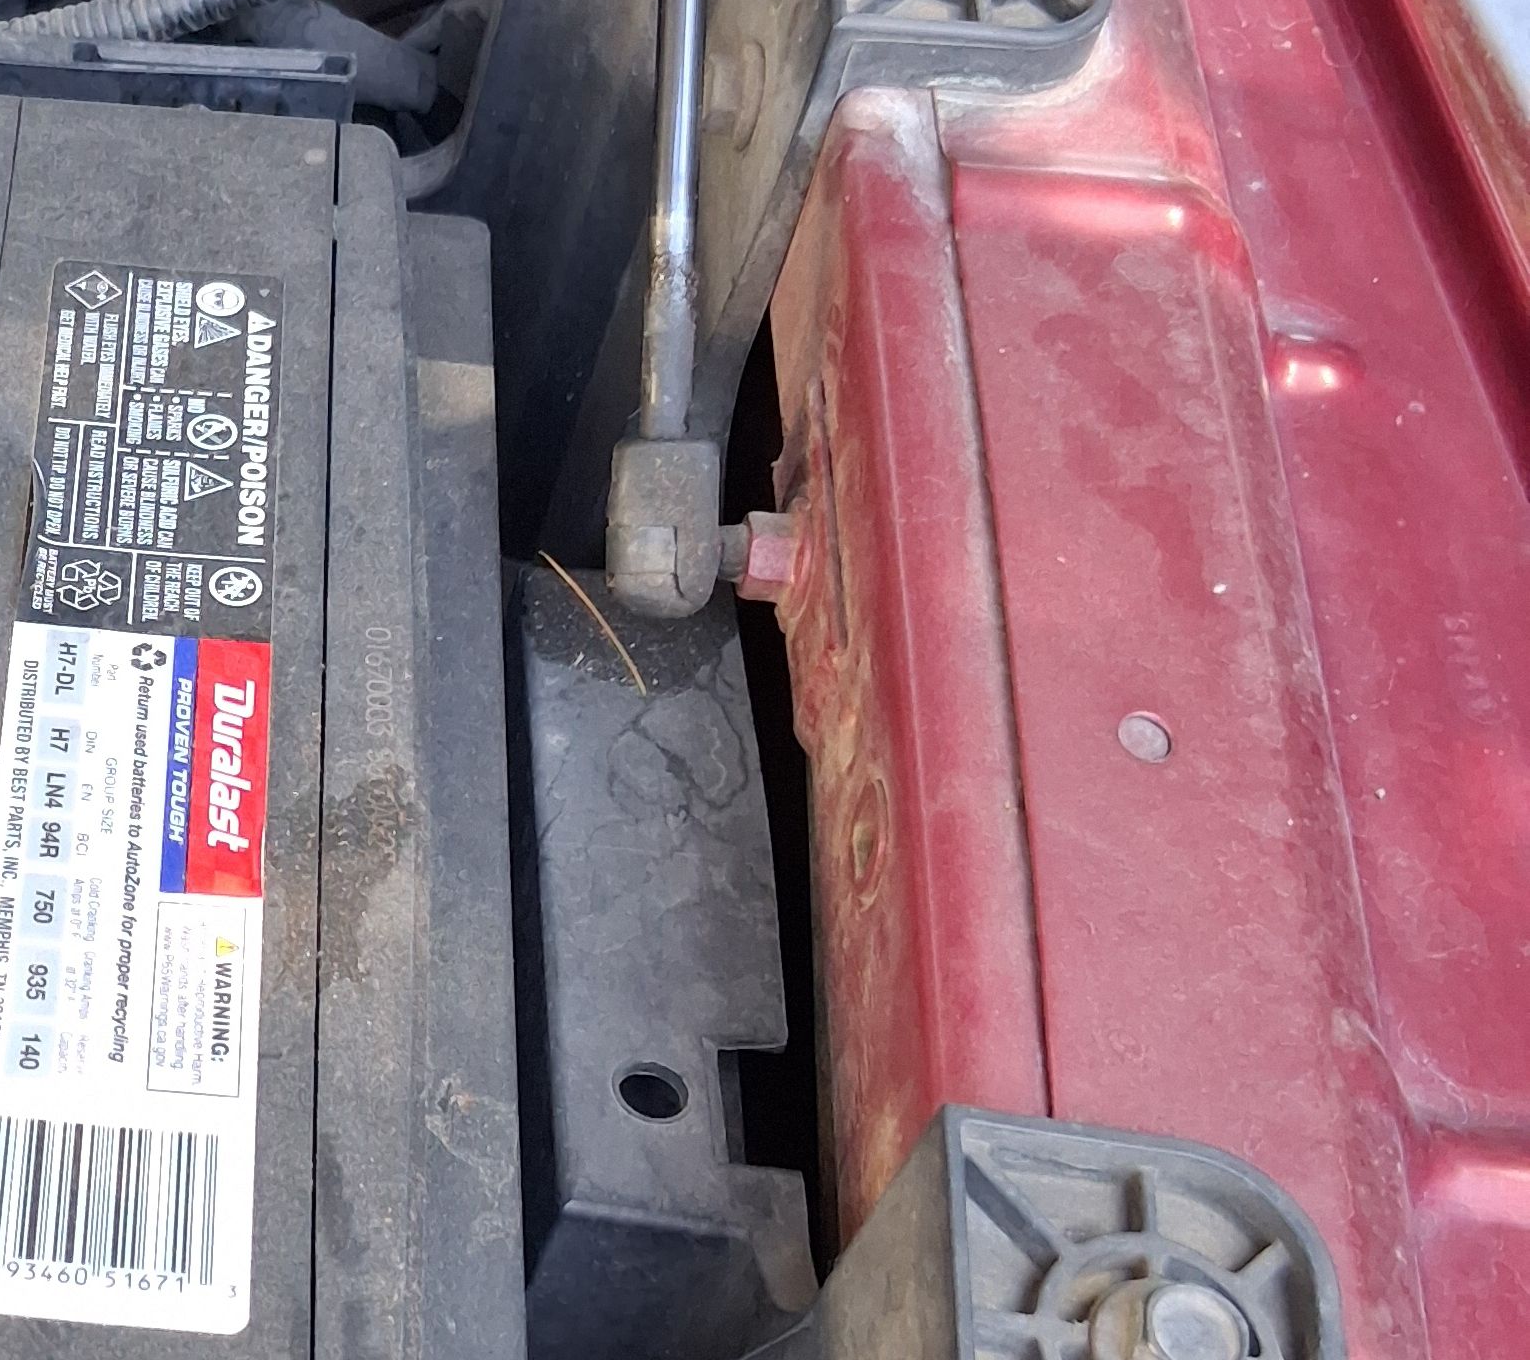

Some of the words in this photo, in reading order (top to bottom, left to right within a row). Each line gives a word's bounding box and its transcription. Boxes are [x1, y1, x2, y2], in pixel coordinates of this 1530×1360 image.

[136, 278, 153, 303] CAUSE
[152, 280, 174, 333] EXPLOSIVE
[173, 281, 193, 316] SHIELD
[57, 308, 75, 326] GET
[82, 310, 100, 334] WITH
[101, 312, 119, 341] FLUSH
[171, 316, 190, 347] EYES.
[54, 325, 74, 363] MEDICAL
[79, 333, 98, 366] WATER.
[99, 340, 117, 363] EYES
[132, 343, 148, 357] OR
[150, 333, 170, 367] GASES
[51, 362, 70, 386] HELP
[148, 366, 165, 384] CAN
[49, 385, 68, 410] FAST.
[186, 397, 206, 414] NO
[53, 425, 71, 440] DO
[124, 400, 144, 445] SMOKING
[145, 402, 163, 440] FLAMES
[165, 403, 183, 441] SPARKS
[51, 439, 70, 459] NOT
[88, 428, 107, 459] READ
[237, 332, 272, 546] DANGER/POISON
[122, 455, 139, 471] OR
[140, 457, 158, 491] CAUSE
[48, 476, 66, 491] DO
[119, 470, 138, 508] SEVERE
[158, 458, 180, 505] SULFURIC
[46, 489, 64, 510] NOT
[43, 509, 63, 536] OPEN.
[135, 490, 156, 546] BLINDNESS
[157, 505, 178, 530] ACID
[36, 546, 48, 560] BE
[155, 529, 174, 549] CAN
[44, 548, 58, 586] BATTERY
[144, 559, 162, 574] OF
[164, 561, 182, 580] THE
[184, 563, 203, 587] KEEP
[30, 559, 47, 610] RECYCLED
[41, 587, 55, 614] MUST
[82, 577, 97, 593] Pb
[140, 573, 161, 623] CHILDREN.
[162, 580, 181, 612] REACH
[183, 586, 201, 607] OUT
[182, 607, 200, 621] OF
[53, 640, 78, 697] H7-DL
[14, 658, 39, 743] DISTRIBUTED
[134, 674, 154, 722] Return
[171, 676, 193, 763] PROVEN
[12, 745, 30, 764] BY
[47, 726, 71, 753] H7
[83, 730, 97, 754] DIN
[132, 723, 150, 758] used
[101, 756, 118, 804] GROUP
[205, 676, 255, 853] Duralast
[8, 767, 28, 802] BEST
[42, 770, 67, 810] LN4
[79, 782, 93, 802] EN
[128, 758, 148, 821] batteries
[98, 807, 114, 835] SIZE
[166, 767, 188, 843] TOUGH
[1, 804, 25, 853] PARTS,
[37, 820, 63, 860] 94R
[74, 831, 89, 857] BCI
[126, 823, 143, 839] to
[69, 877, 85, 905] Amps
[87, 876, 102, 899] Cold
[121, 840, 142, 912] AutoZone
[31, 887, 56, 925] 750
[81, 899, 100, 943] Cranking
[119, 914, 137, 938] for
[77, 950, 96, 992] Cranking
[112, 937, 133, 991] proper
[23, 962, 49, 1001] 935
[77, 993, 92, 1021] Amps
[209, 960, 233, 1063] WARNING:
[106, 991, 131, 1064] recycling
[17, 1031, 43, 1072] 140
[5, 1260, 88, 1287] 93460
[103, 1270, 184, 1294] 51671
[227, 1283, 237, 1298] 3
